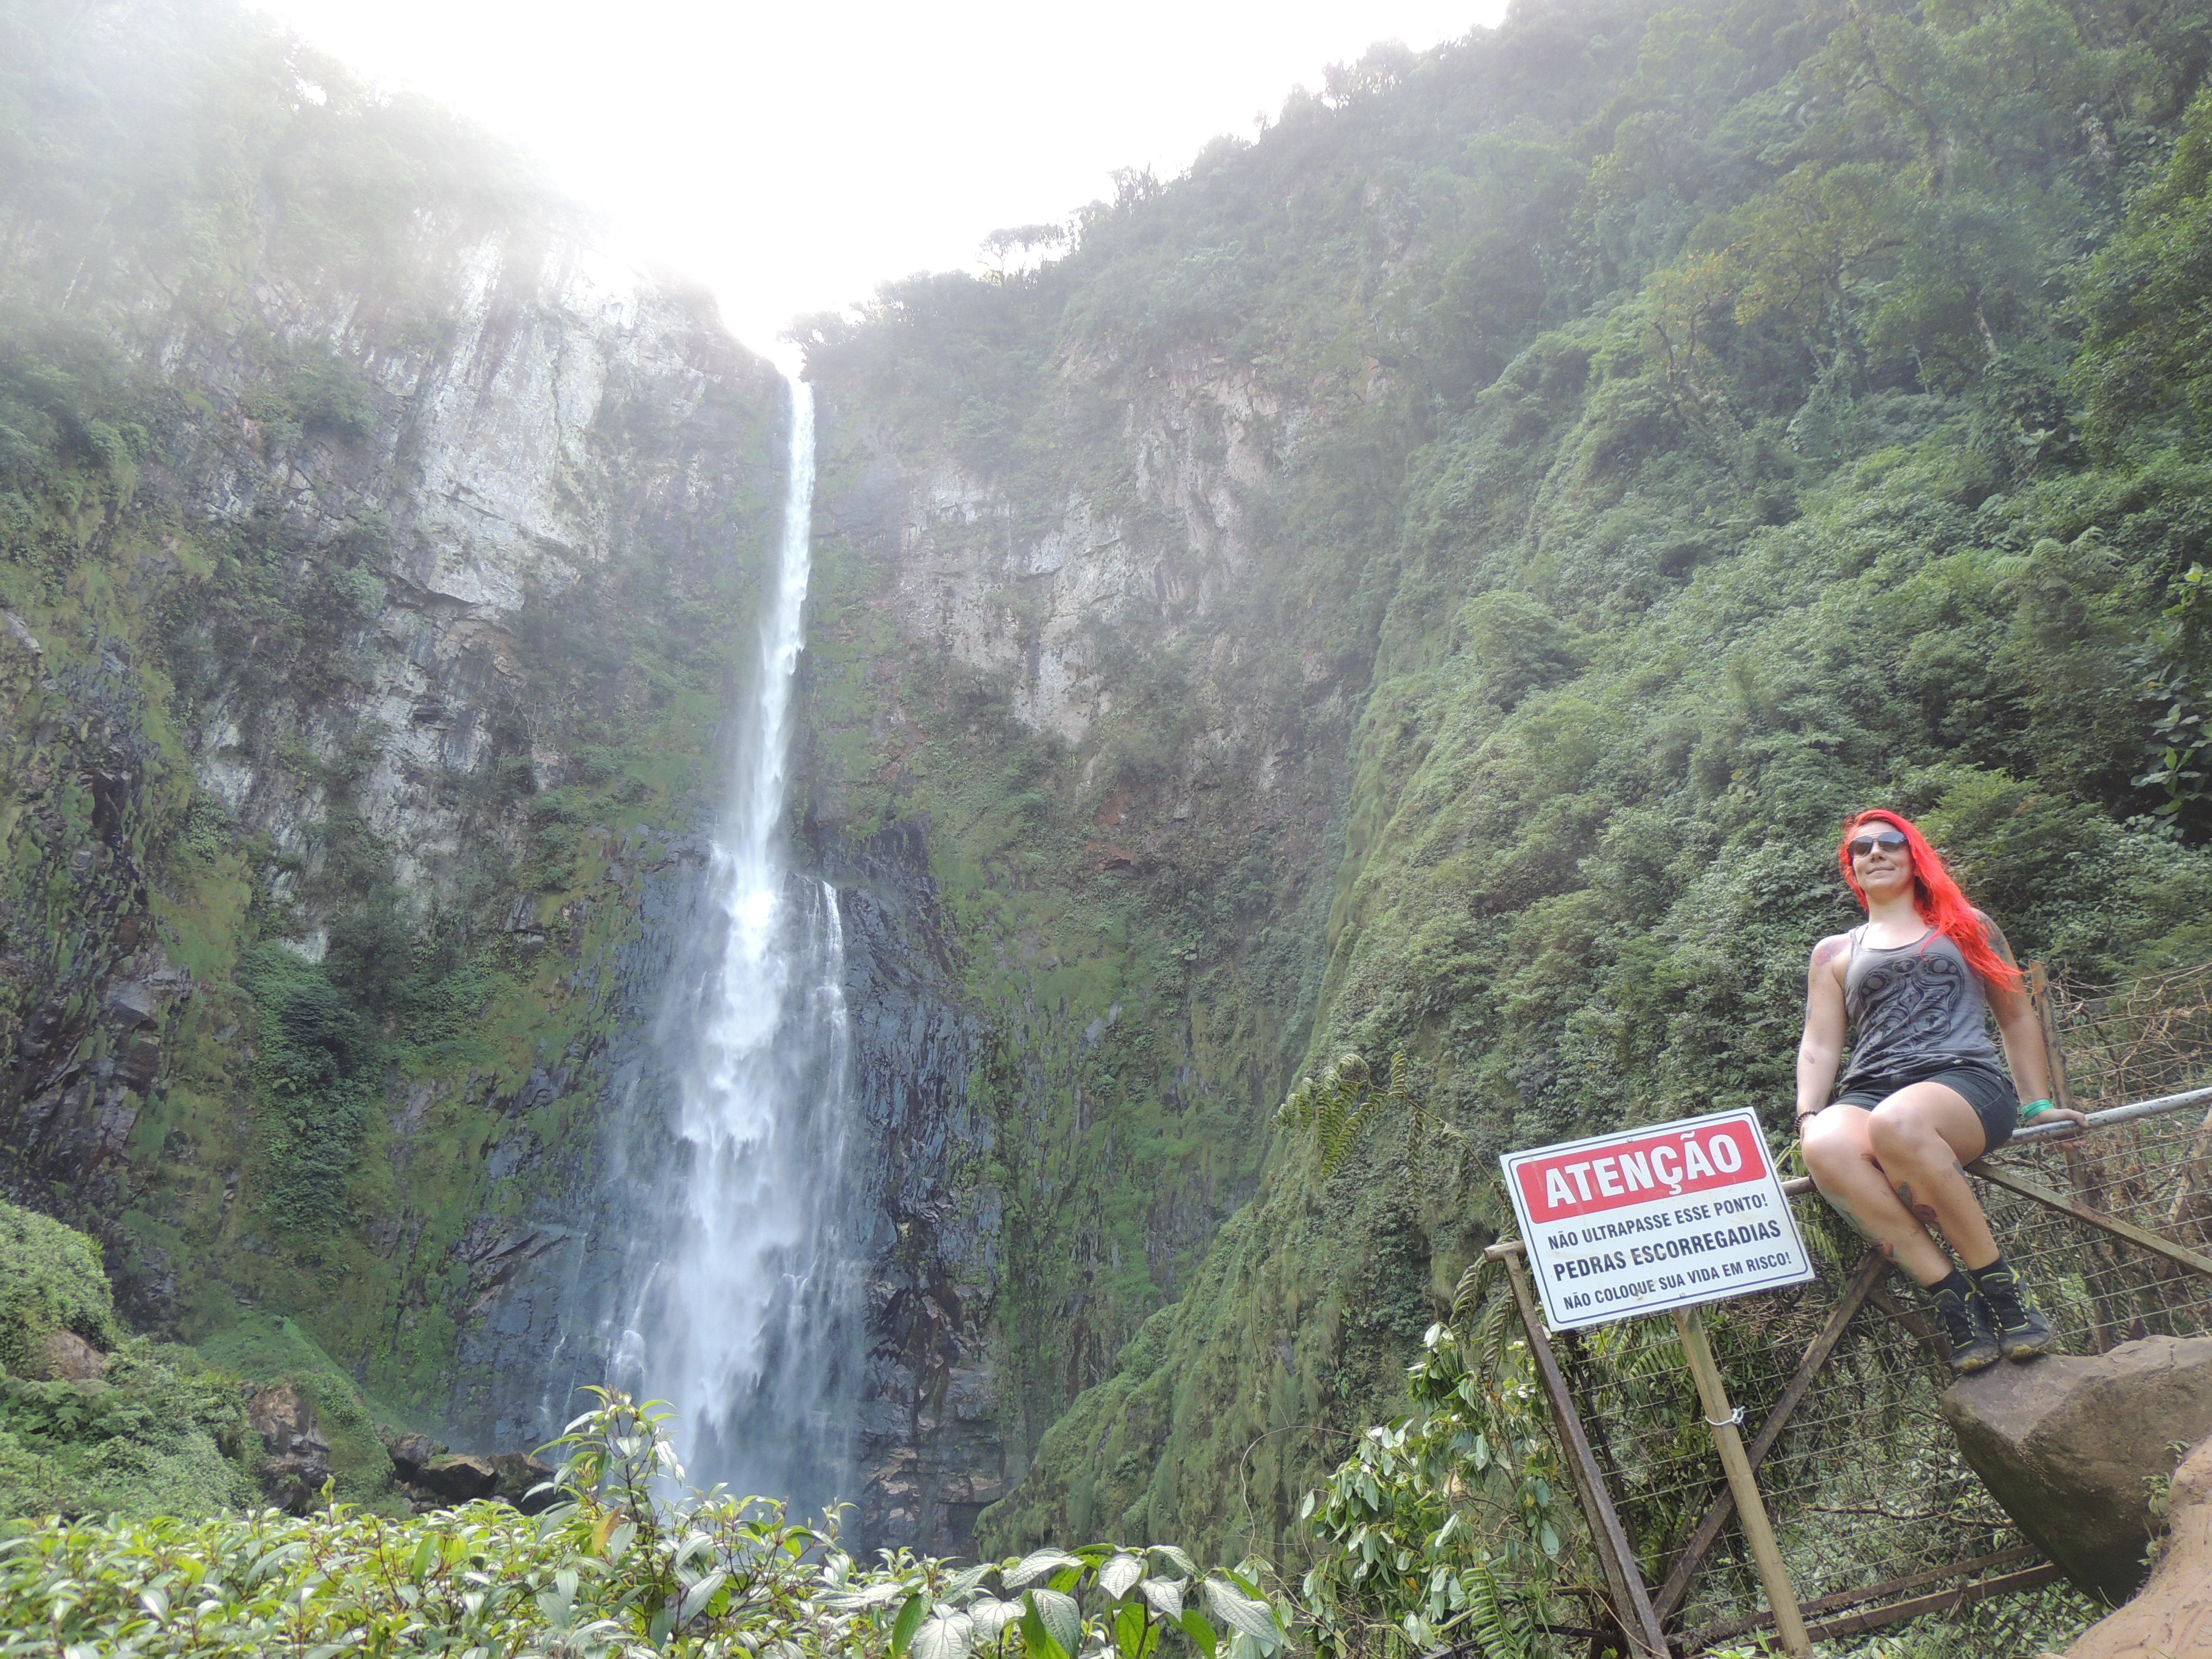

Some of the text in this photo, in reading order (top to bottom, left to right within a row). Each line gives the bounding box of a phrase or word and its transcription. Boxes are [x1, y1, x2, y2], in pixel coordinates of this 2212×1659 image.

[1545, 1131, 1742, 1208] ATENÇÃO
[1548, 1193, 1768, 1250] NÃO ULTRAPASSE ESSE PONTO!
[1553, 1220, 1780, 1281] PEDRAS ESCORREGADIAS
[1563, 1251, 1791, 1310] NÃO COLOQUE SUA VIDA EM RISCO!
